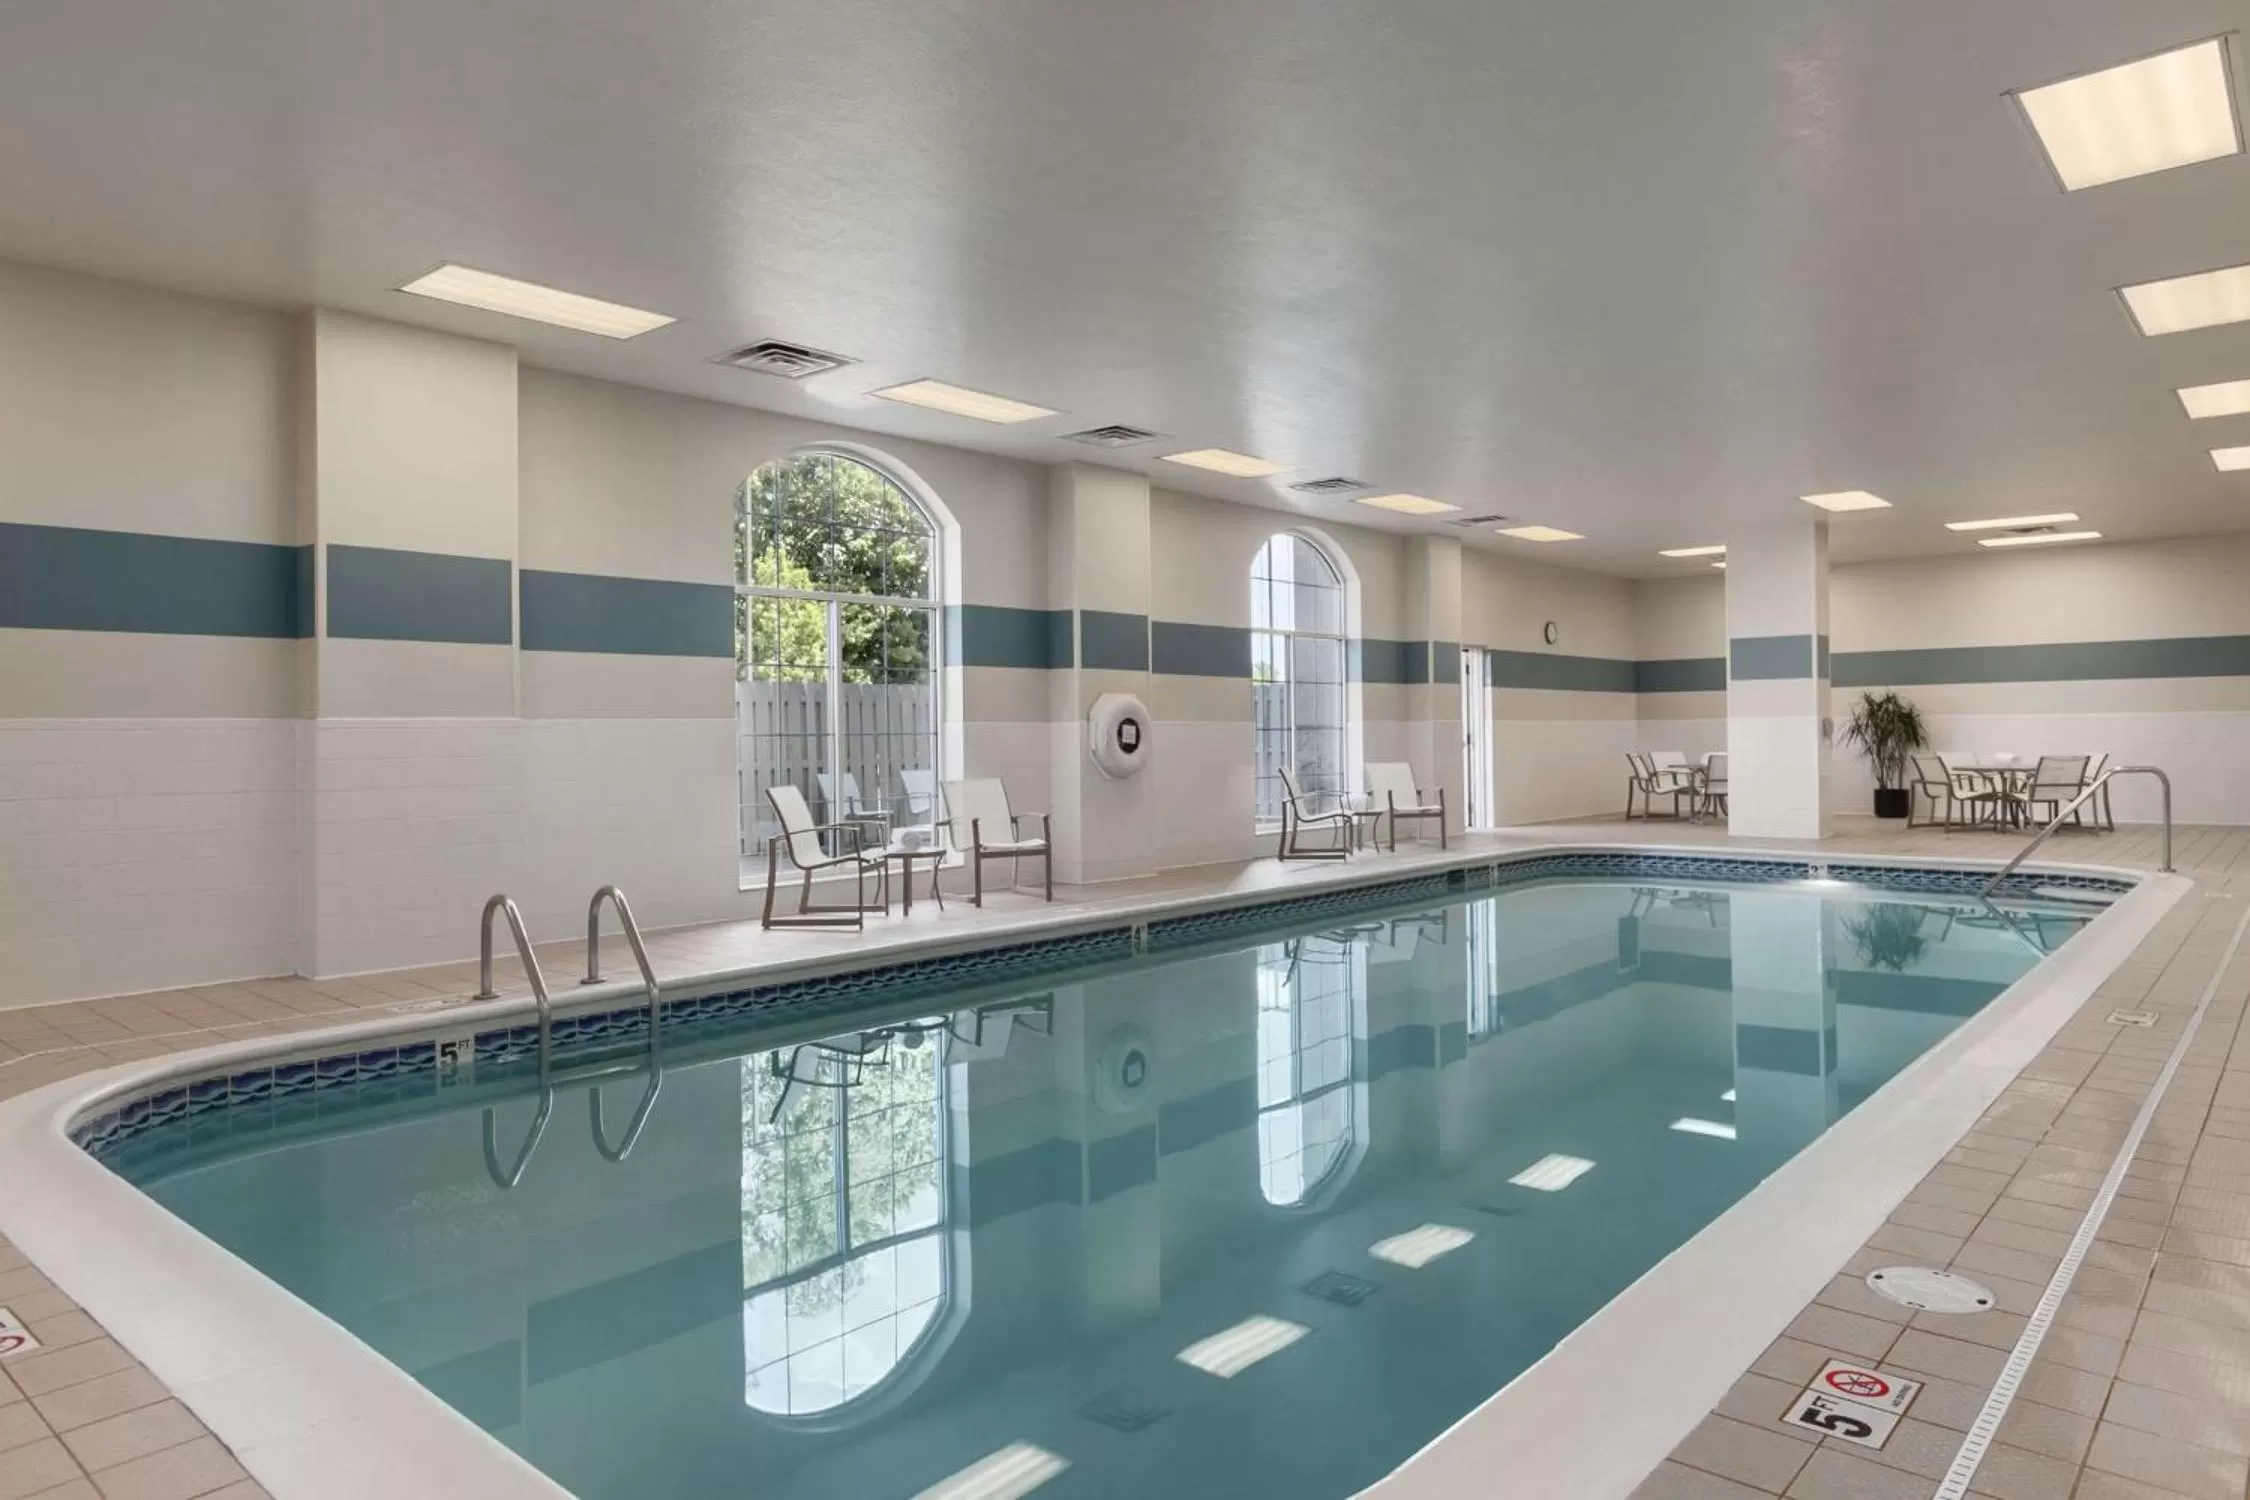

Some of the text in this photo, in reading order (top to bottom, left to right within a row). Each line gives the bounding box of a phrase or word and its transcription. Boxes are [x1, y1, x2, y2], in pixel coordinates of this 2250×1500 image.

[441, 1039, 470, 1064] 5 FT
[1800, 1395, 1872, 1437] 5 FT
